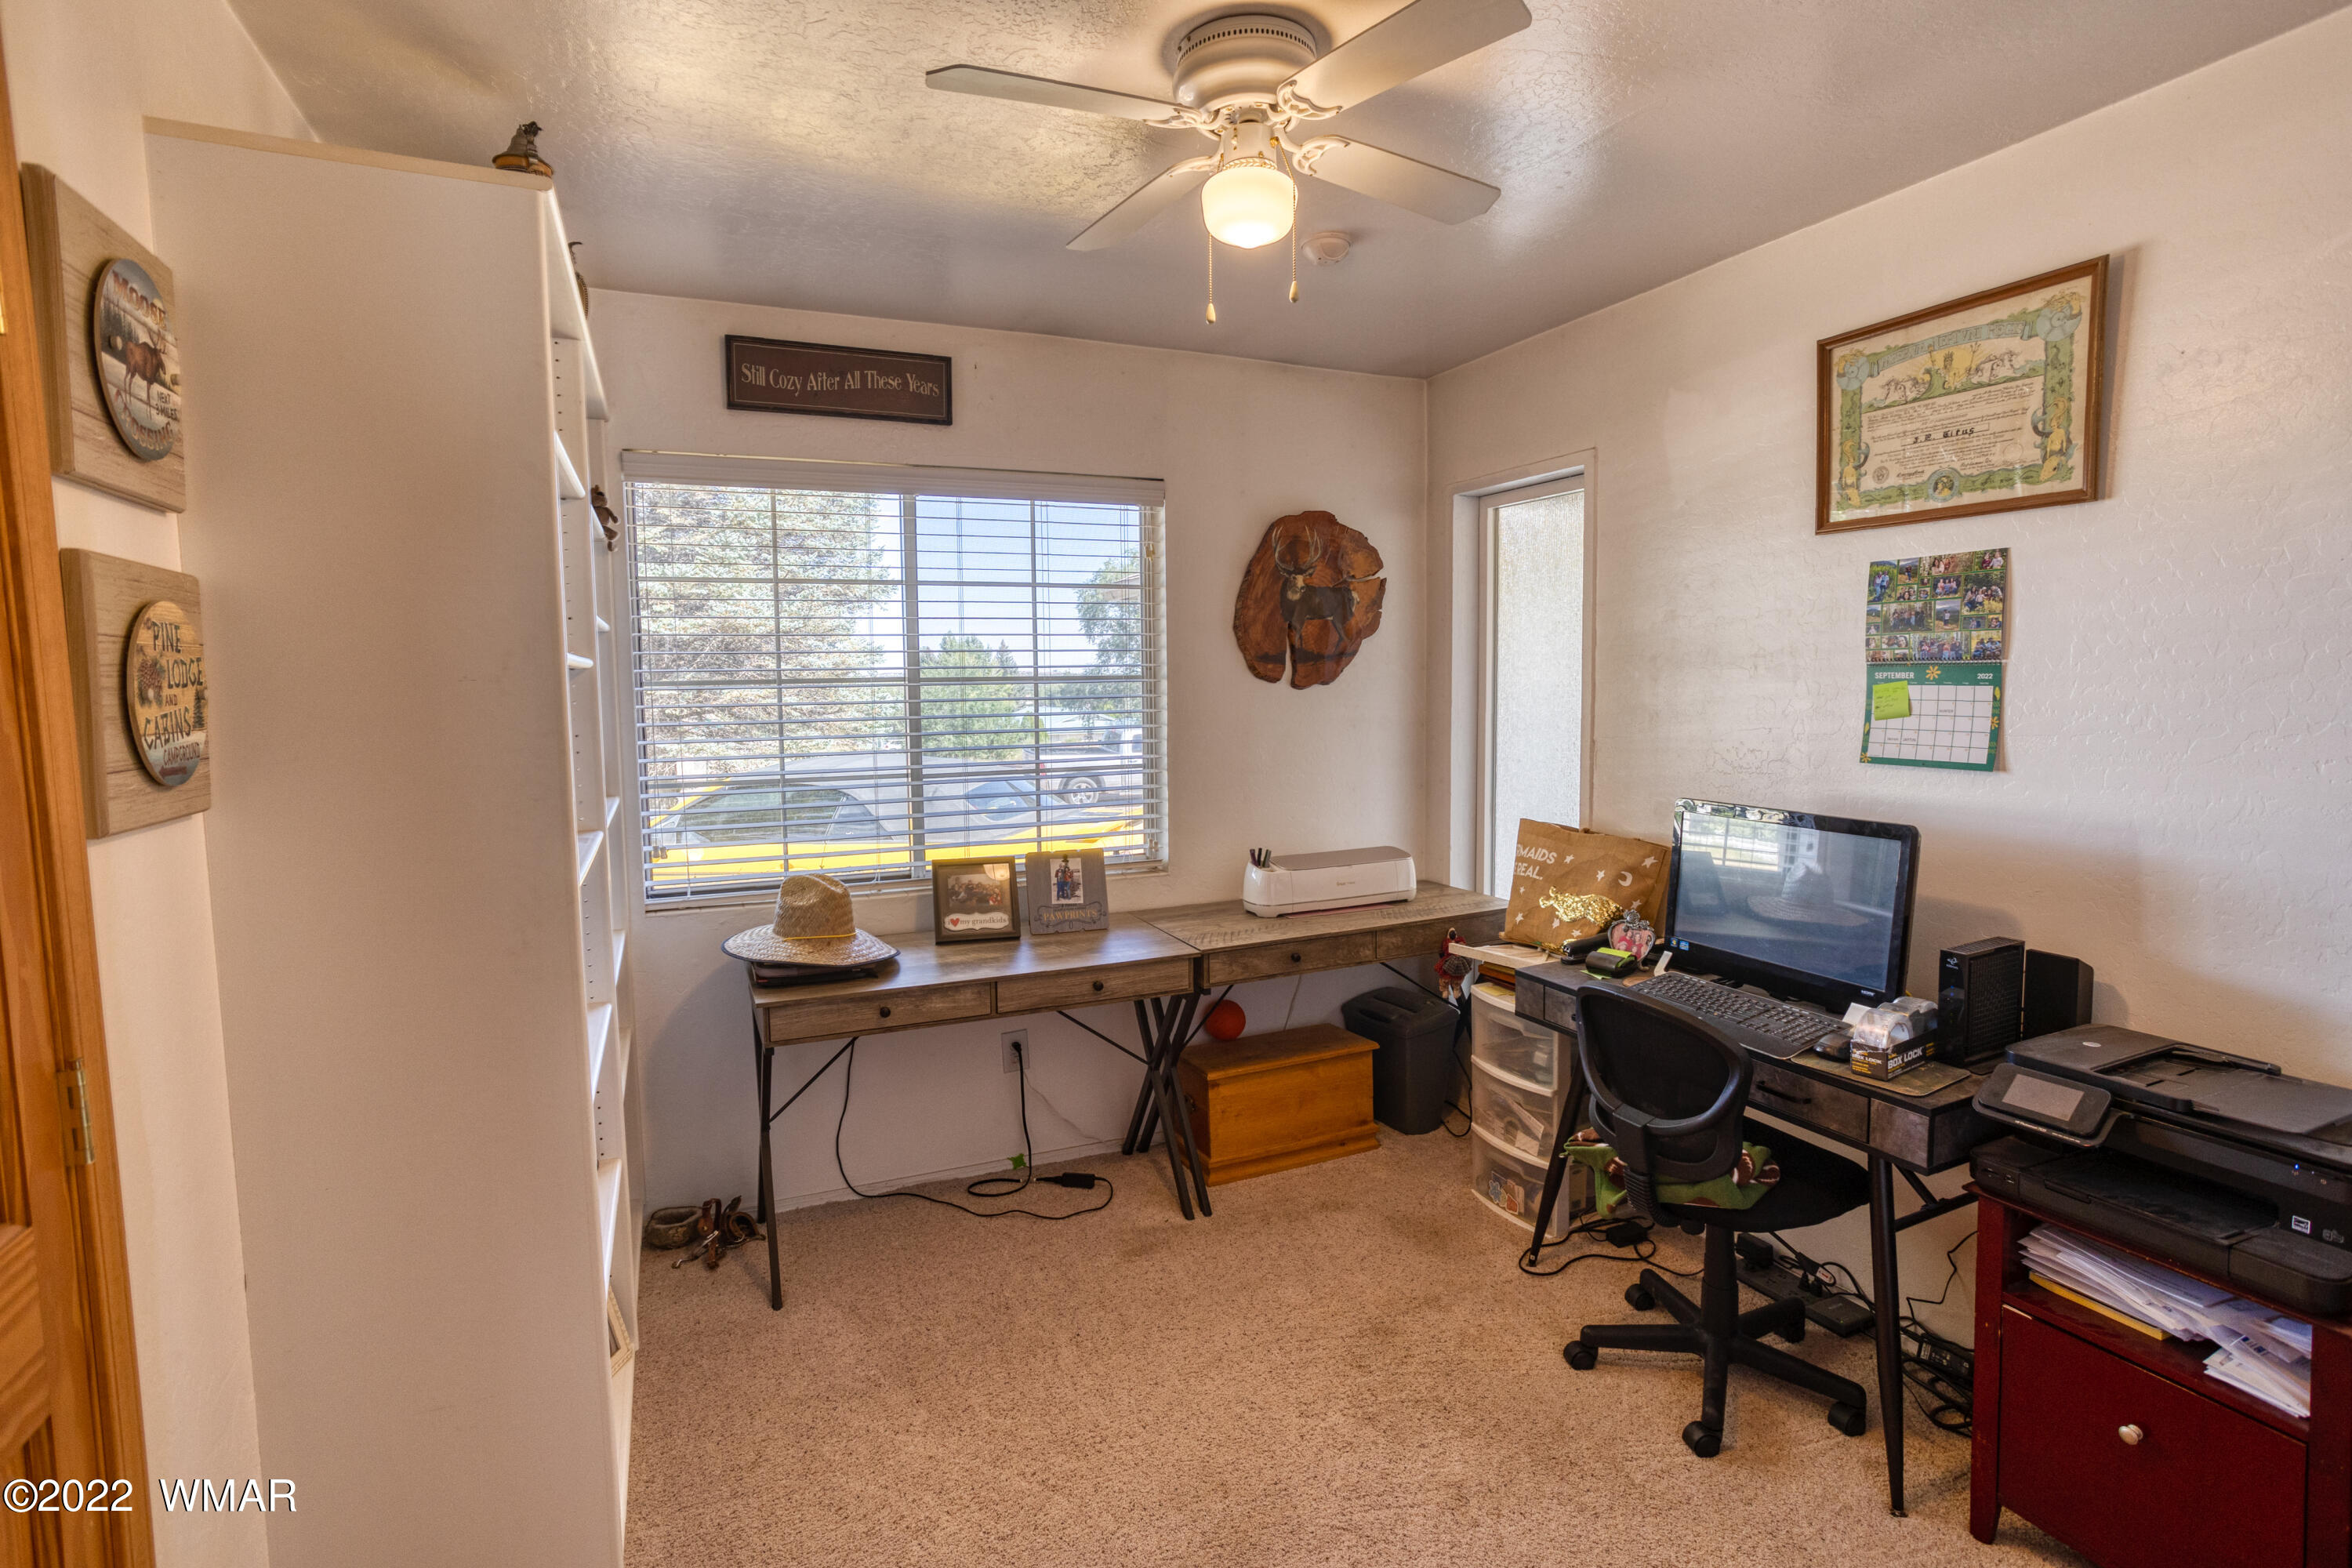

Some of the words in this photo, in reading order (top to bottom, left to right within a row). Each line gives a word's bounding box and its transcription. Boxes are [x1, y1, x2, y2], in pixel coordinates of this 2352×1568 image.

[113, 270, 167, 331] MOOSE
[741, 363, 765, 387] Still
[769, 368, 803, 397] Cozy
[807, 372, 840, 391] After
[844, 370, 860, 390] All
[864, 370, 902, 390] These
[906, 372, 940, 397] Years
[157, 391, 171, 405] NEXT
[152, 621, 181, 653] PINE
[166, 657, 204, 689] LODGE
[165, 694, 179, 706] AND
[143, 706, 191, 750] CABINS
[163, 742, 201, 766] CAMPGROUND
[972, 916, 1007, 926] grandkids
[1044, 909, 1098, 922] PAWPRINTS
[1888, 1056, 1903, 1069] BOX
[1904, 1047, 1923, 1062] LOCK
